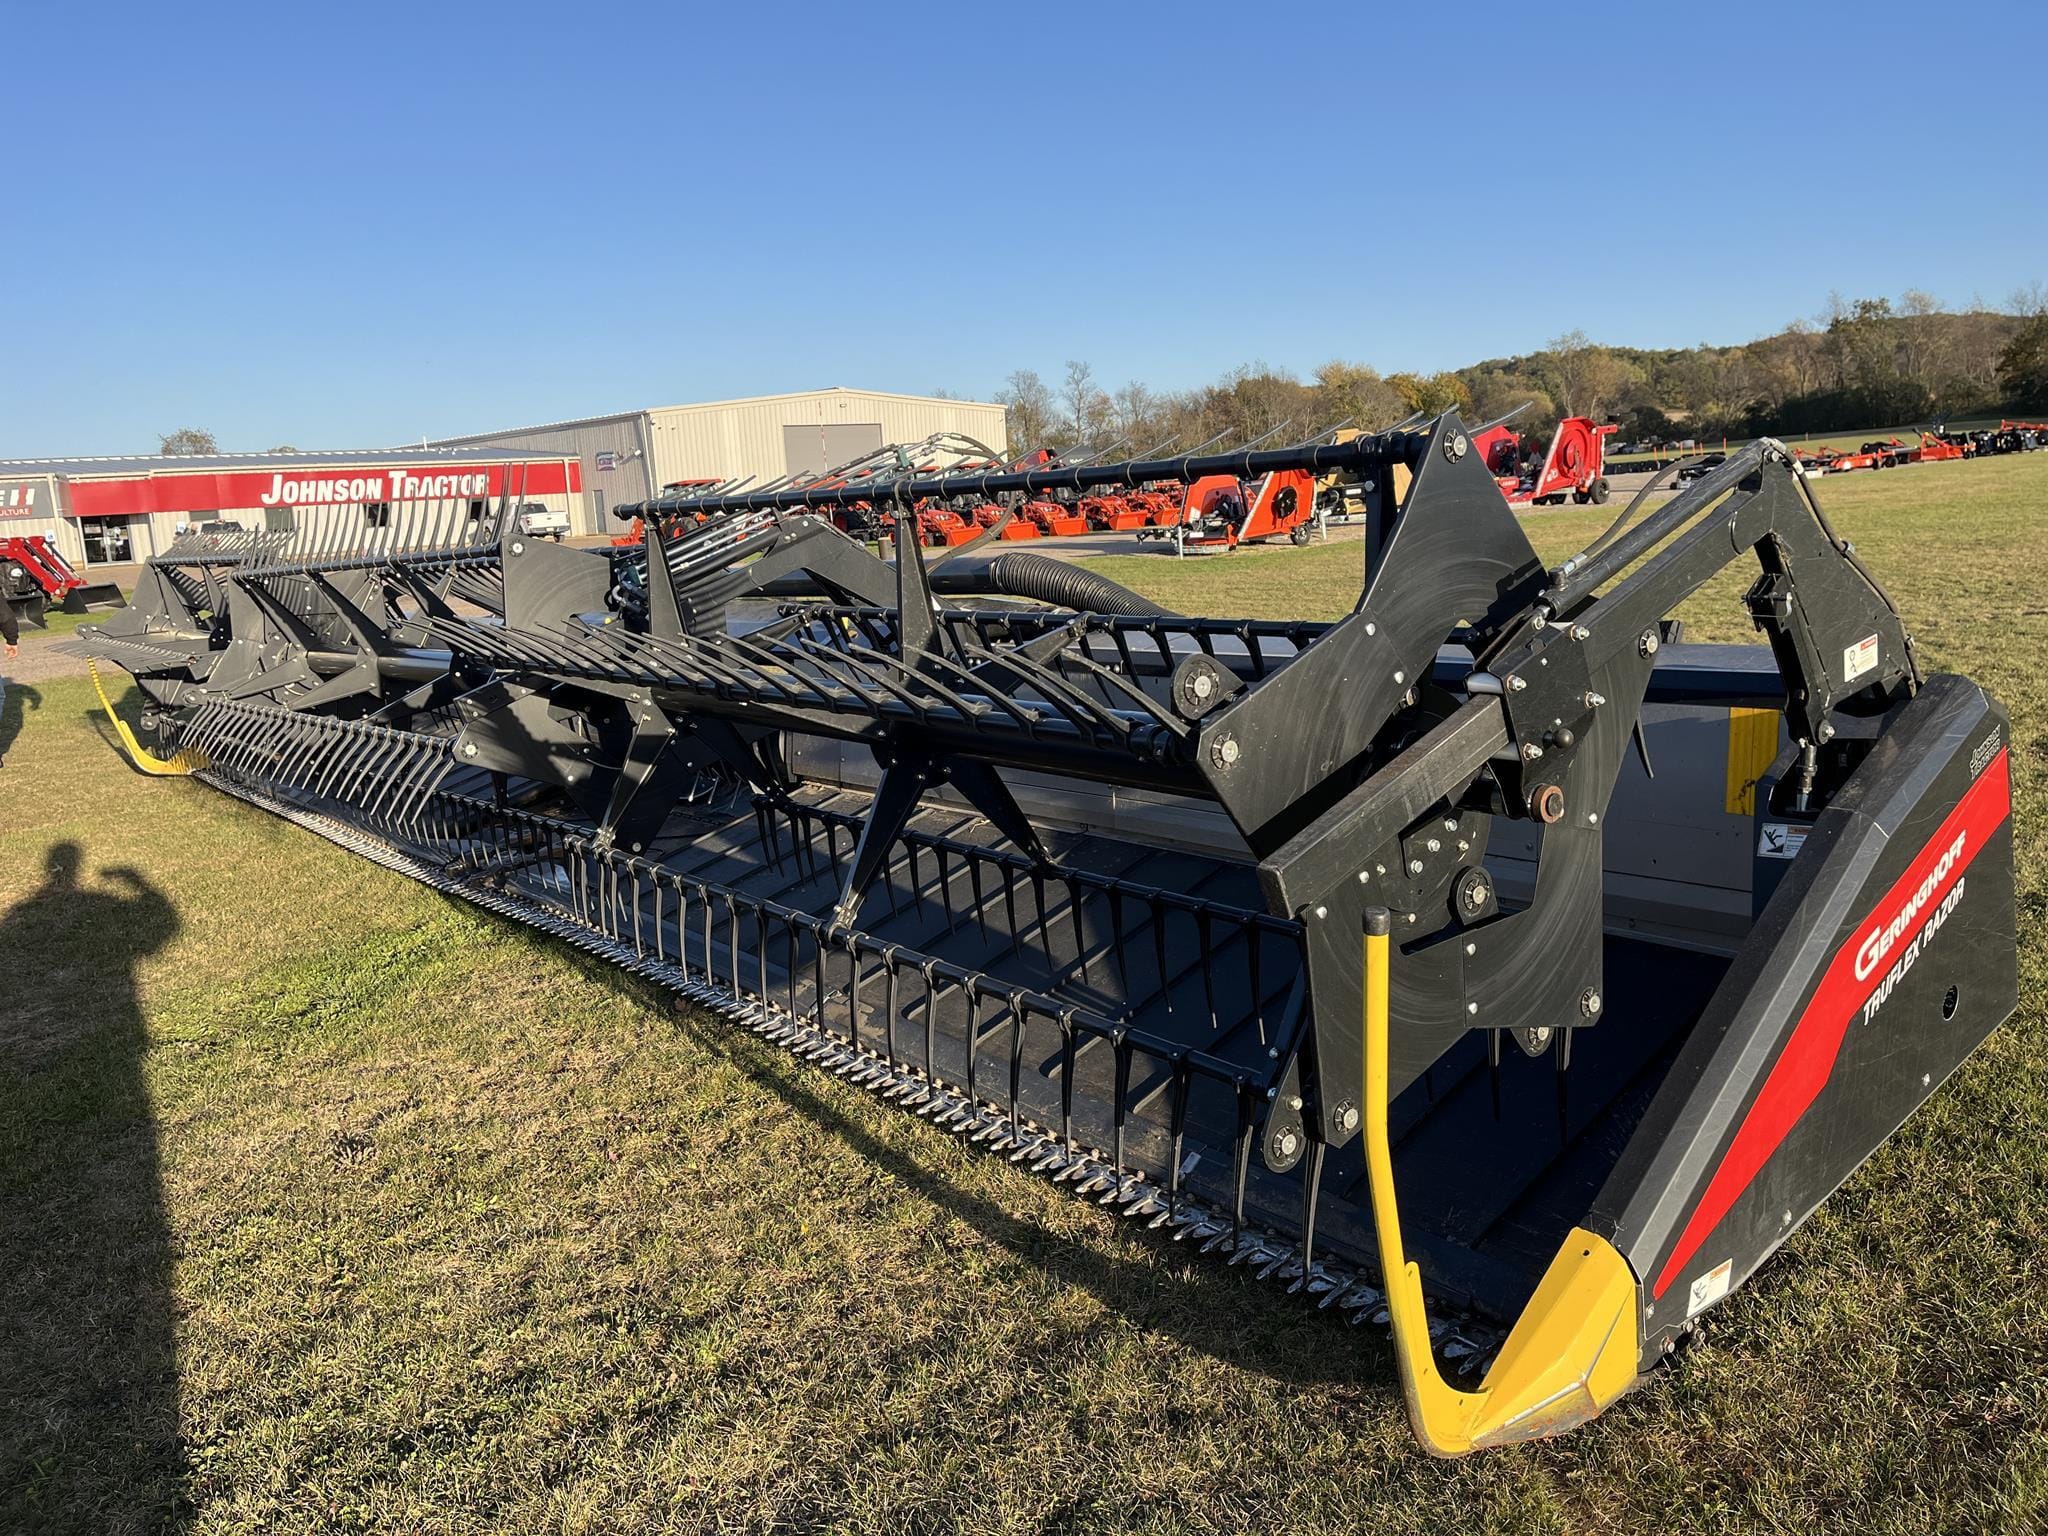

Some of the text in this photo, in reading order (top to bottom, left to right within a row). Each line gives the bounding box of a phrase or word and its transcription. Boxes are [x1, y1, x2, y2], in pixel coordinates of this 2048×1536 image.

[261, 470, 489, 504] JOHNSON TRACTOR
[1855, 830, 1966, 981] GERINGHOFF
[1863, 877, 1965, 1026] TRUFLEX RAZOR
